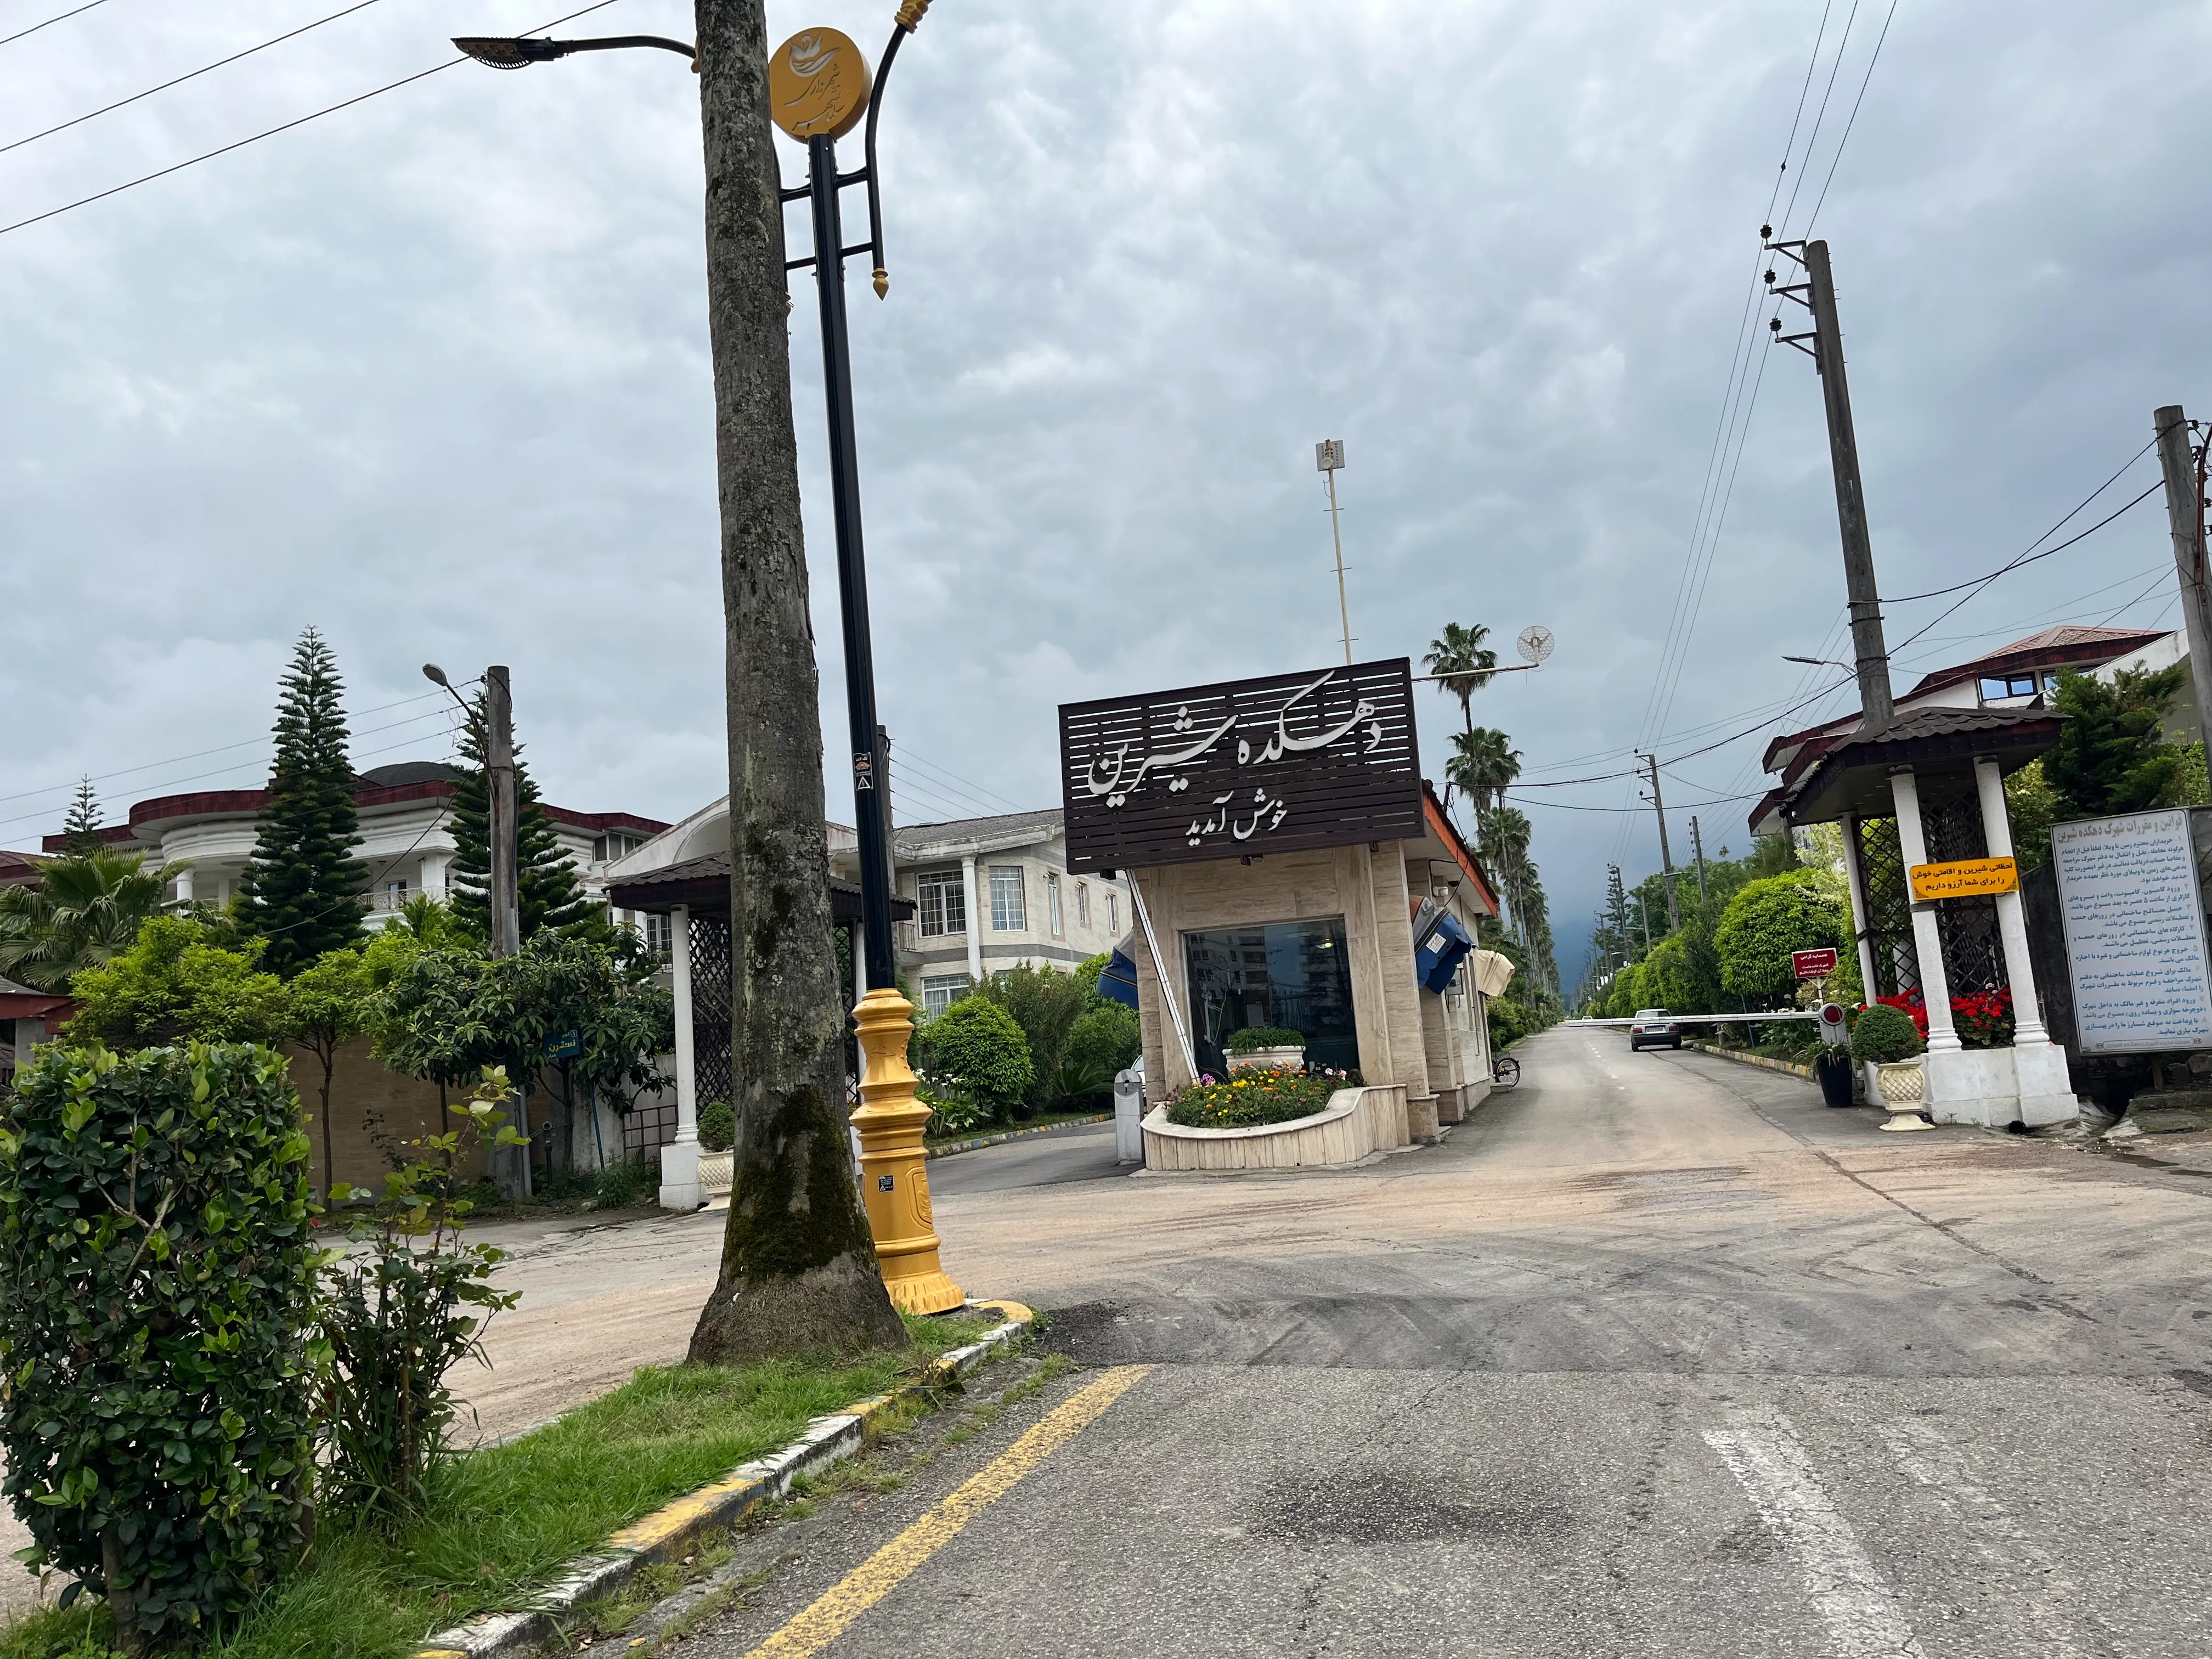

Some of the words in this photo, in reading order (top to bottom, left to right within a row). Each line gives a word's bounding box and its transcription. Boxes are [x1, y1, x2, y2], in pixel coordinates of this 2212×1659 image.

[1238, 670, 1382, 765] دهکده
[1087, 705, 1239, 808] شیرین
[1185, 790, 1235, 847] آمدید
[1233, 787, 1288, 840] خوش
[1964, 865, 1988, 874] شیرین
[1989, 862, 2012, 872] لحظاتی
[1912, 871, 1932, 880] خوش
[1933, 868, 1955, 878] اقامتی
[1926, 883, 1946, 891] داریم
[1948, 879, 1963, 889] آرزو
[1980, 878, 1996, 886] برای
[549, 1039, 576, 1053] نسترن
